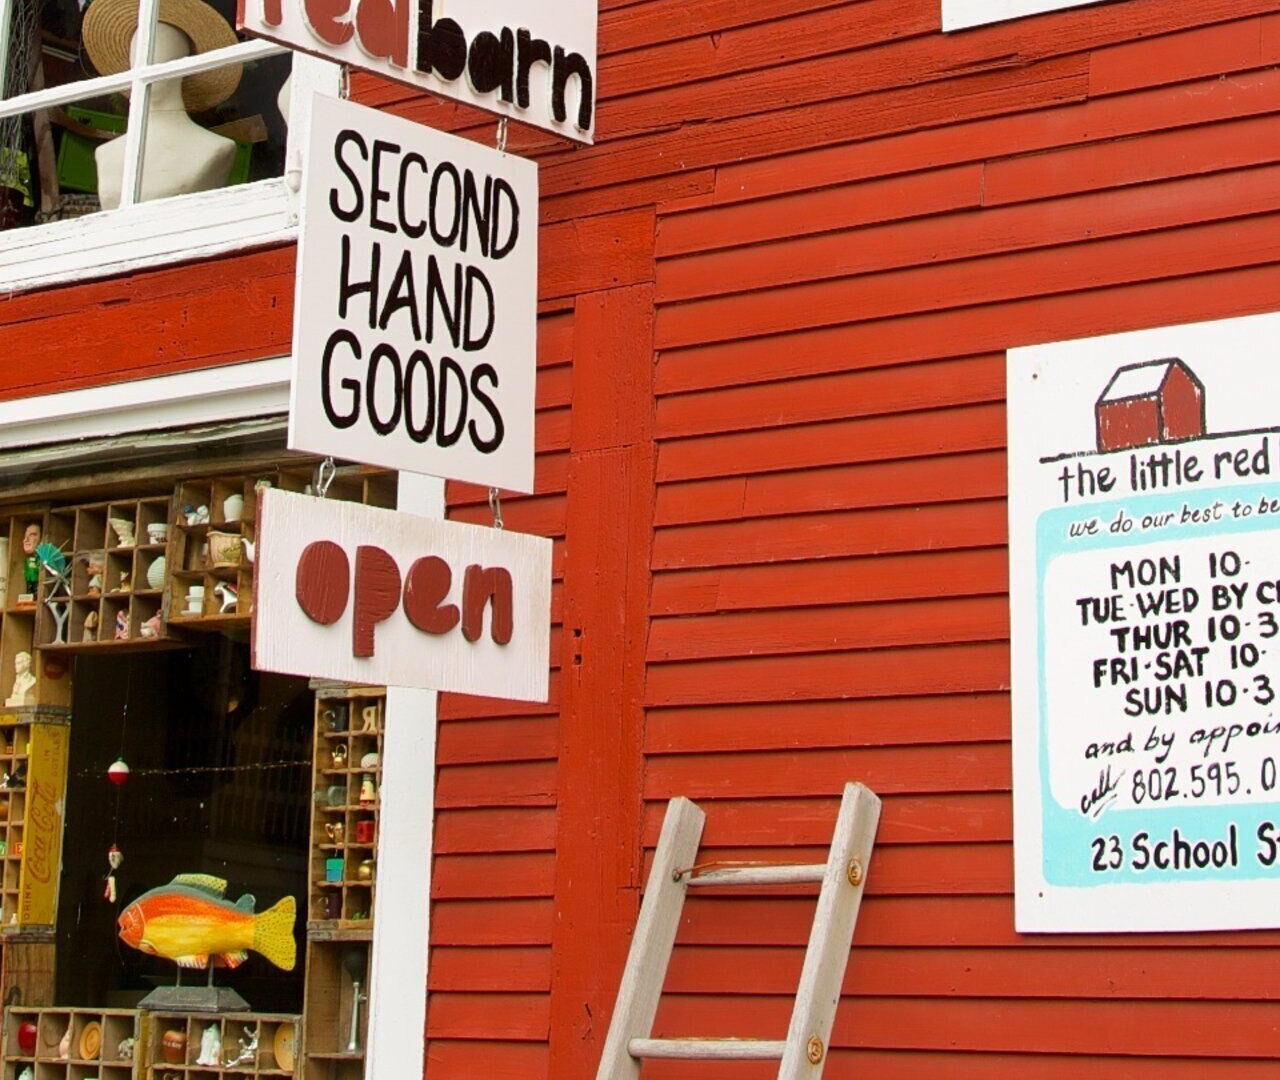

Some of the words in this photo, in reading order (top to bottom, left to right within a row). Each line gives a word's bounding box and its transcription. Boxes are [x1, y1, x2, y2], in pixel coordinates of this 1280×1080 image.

[329, 128, 520, 260] SECOND
[338, 233, 496, 352] HAND
[320, 328, 505, 454] GOODS
[1058, 462, 1116, 502] the
[1129, 451, 1204, 491] little
[1214, 437, 1270, 480] red
[1069, 520, 1098, 537] we
[1110, 510, 1132, 534] do
[1142, 513, 1174, 531] our
[1180, 501, 1223, 525] best
[1231, 502, 1253, 520] to
[1258, 497, 1280, 514] be
[1110, 555, 1181, 590] MON
[295, 539, 515, 658] open
[1212, 582, 1248, 611] BY
[1110, 620, 1192, 653] THUR
[1124, 683, 1187, 716] SUN
[1085, 732, 1134, 759] and
[1144, 726, 1175, 763] by
[1091, 834, 1123, 871] 23
[1132, 824, 1238, 870] School
